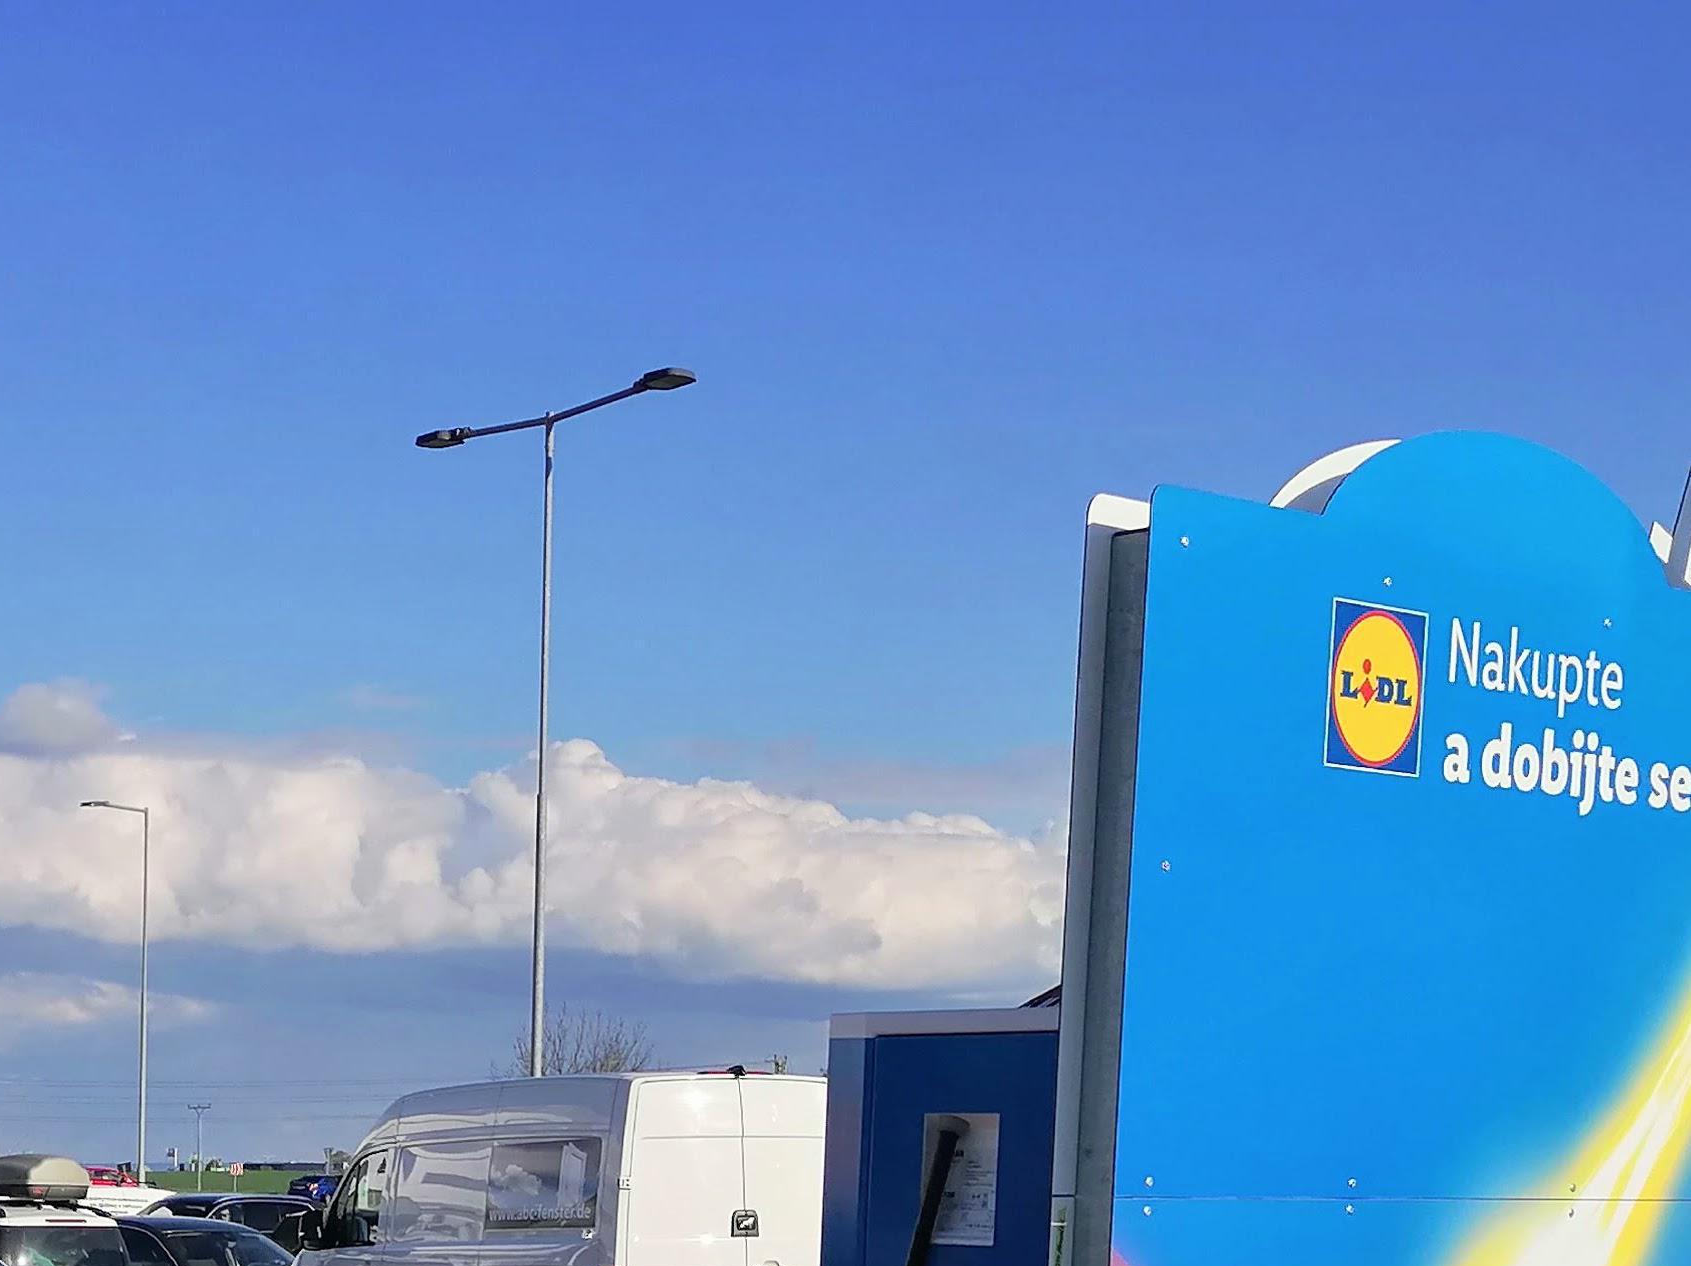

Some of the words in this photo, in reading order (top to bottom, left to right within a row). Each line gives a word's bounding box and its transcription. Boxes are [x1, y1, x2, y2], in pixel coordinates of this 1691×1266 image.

[1448, 617, 1625, 718] Nakupte
[1443, 731, 1470, 784] a
[1481, 721, 1639, 816] dobijte
[1648, 760, 1691, 813] se
